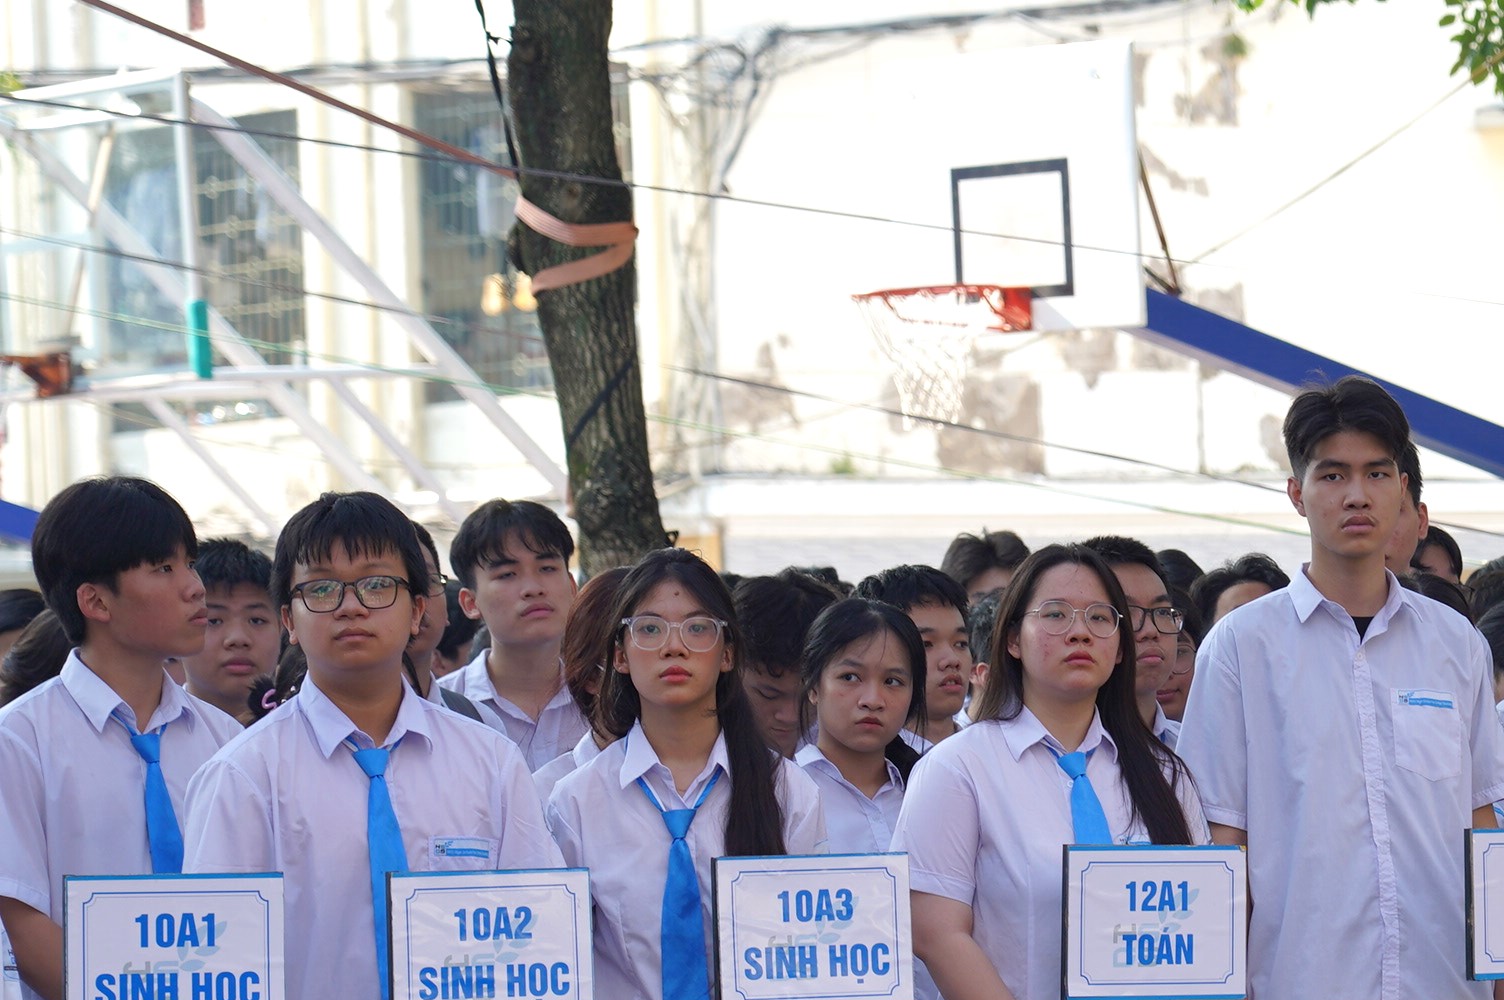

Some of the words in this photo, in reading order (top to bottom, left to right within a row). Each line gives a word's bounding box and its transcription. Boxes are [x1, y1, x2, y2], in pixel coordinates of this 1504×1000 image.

[777, 888, 854, 922] 10A3
[1125, 880, 1188, 912] 12A1
[135, 913, 215, 948] 10A1
[454, 906, 533, 941] 10A2
[744, 945, 818, 981] SINH
[829, 942, 890, 984] HỌC
[1122, 927, 1194, 966] TOÁN
[418, 964, 495, 1000] SINH
